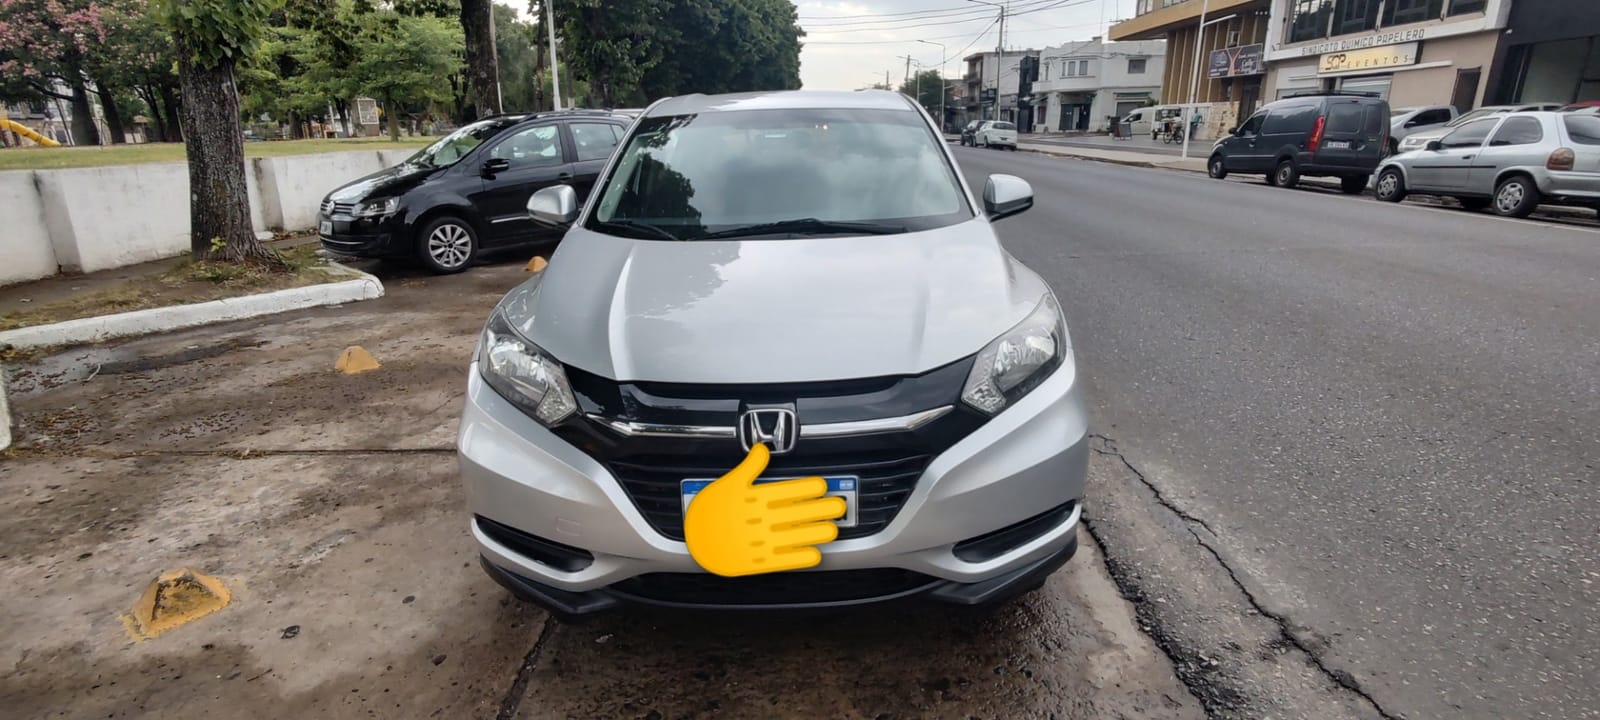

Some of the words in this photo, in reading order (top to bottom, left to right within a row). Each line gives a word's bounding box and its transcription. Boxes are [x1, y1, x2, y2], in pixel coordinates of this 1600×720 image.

[1301, 42, 1339, 56] SINDICATO
[1341, 38, 1374, 50] QUIMICO
[1376, 28, 1425, 43] PAPELERO
[1347, 54, 1409, 68] EVENTOS
